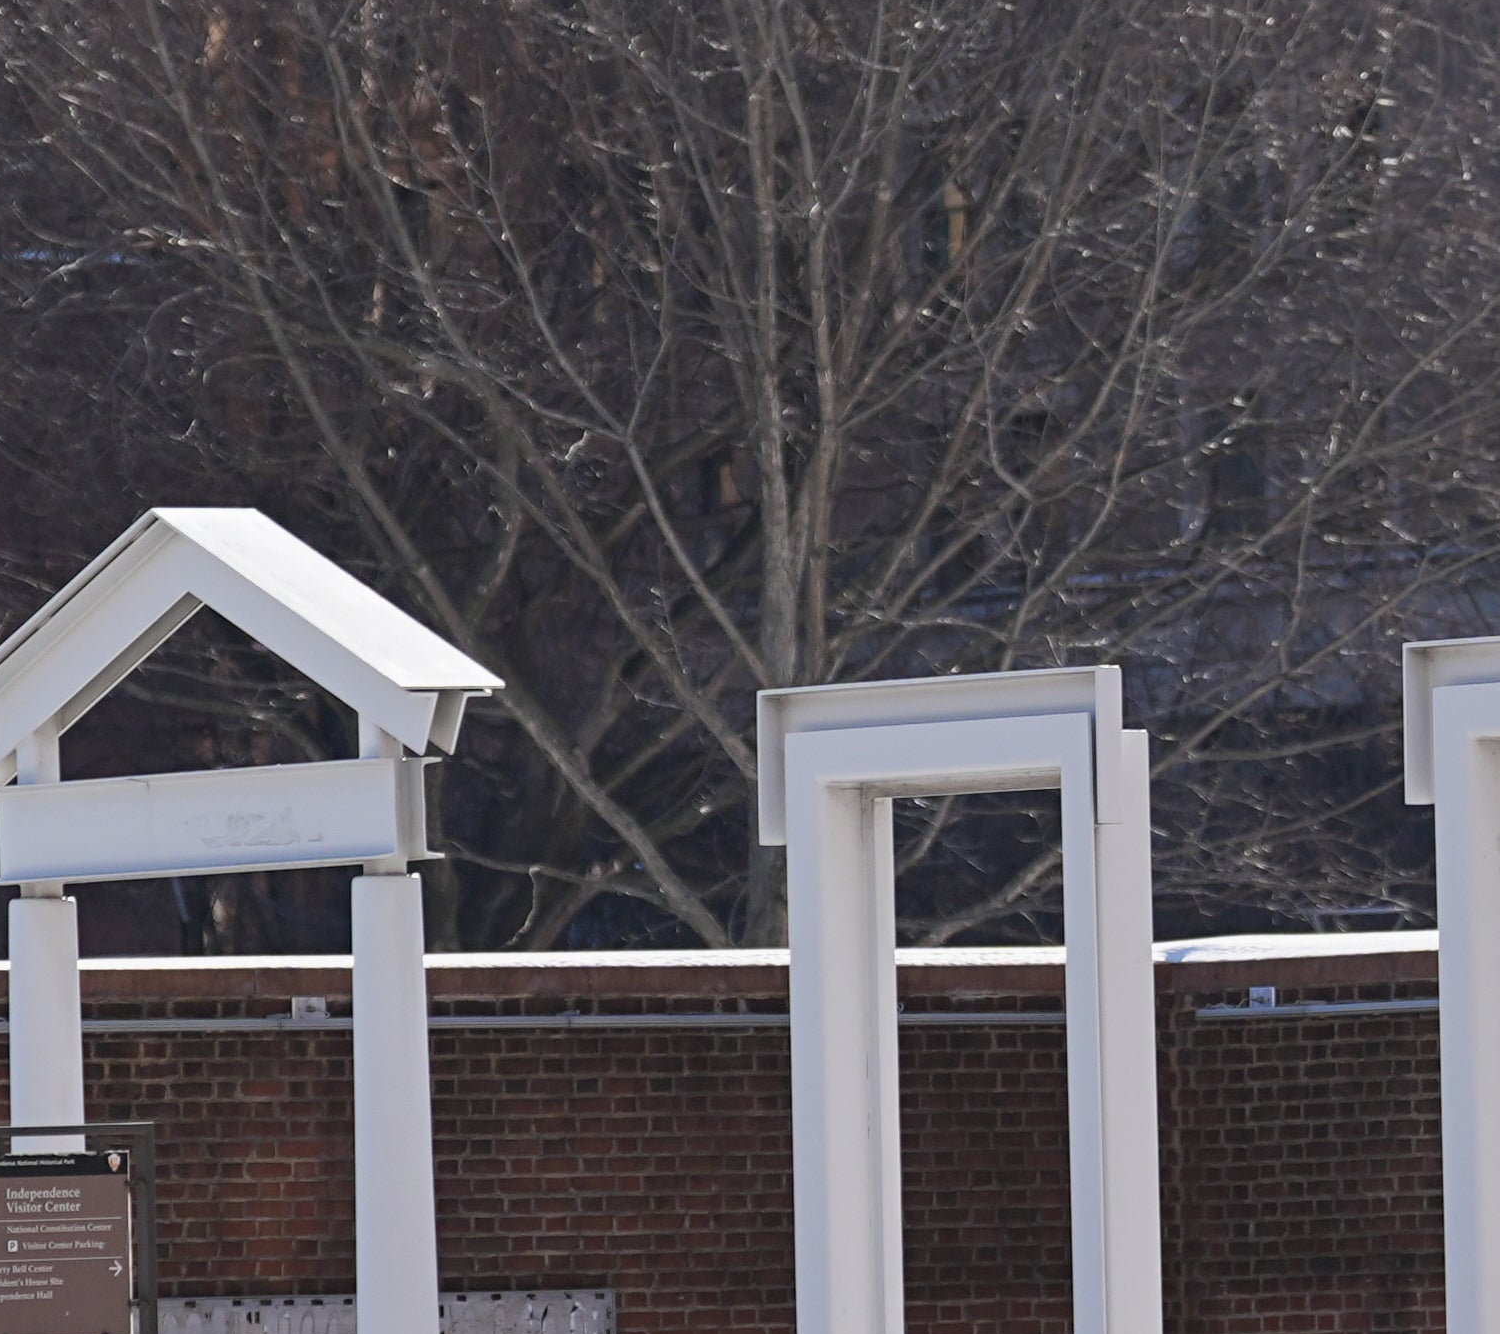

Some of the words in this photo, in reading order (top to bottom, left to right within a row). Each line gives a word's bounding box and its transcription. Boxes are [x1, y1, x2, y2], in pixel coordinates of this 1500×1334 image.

[6, 1187, 81, 1202] Independence
[6, 1202, 42, 1213] Visitor
[44, 1201, 81, 1212] Center
[7, 1225, 39, 1234] National
[87, 1223, 112, 1232] Center
[22, 1242, 47, 1250] Visitor
[48, 1241, 73, 1250] Center
[74, 1240, 104, 1249] Parking
[12, 1264, 28, 1274] Bell
[28, 1264, 53, 1273] Center
[25, 1278, 49, 1287] House
[50, 1277, 63, 1285] Site
[36, 1290, 53, 1300] Hall
